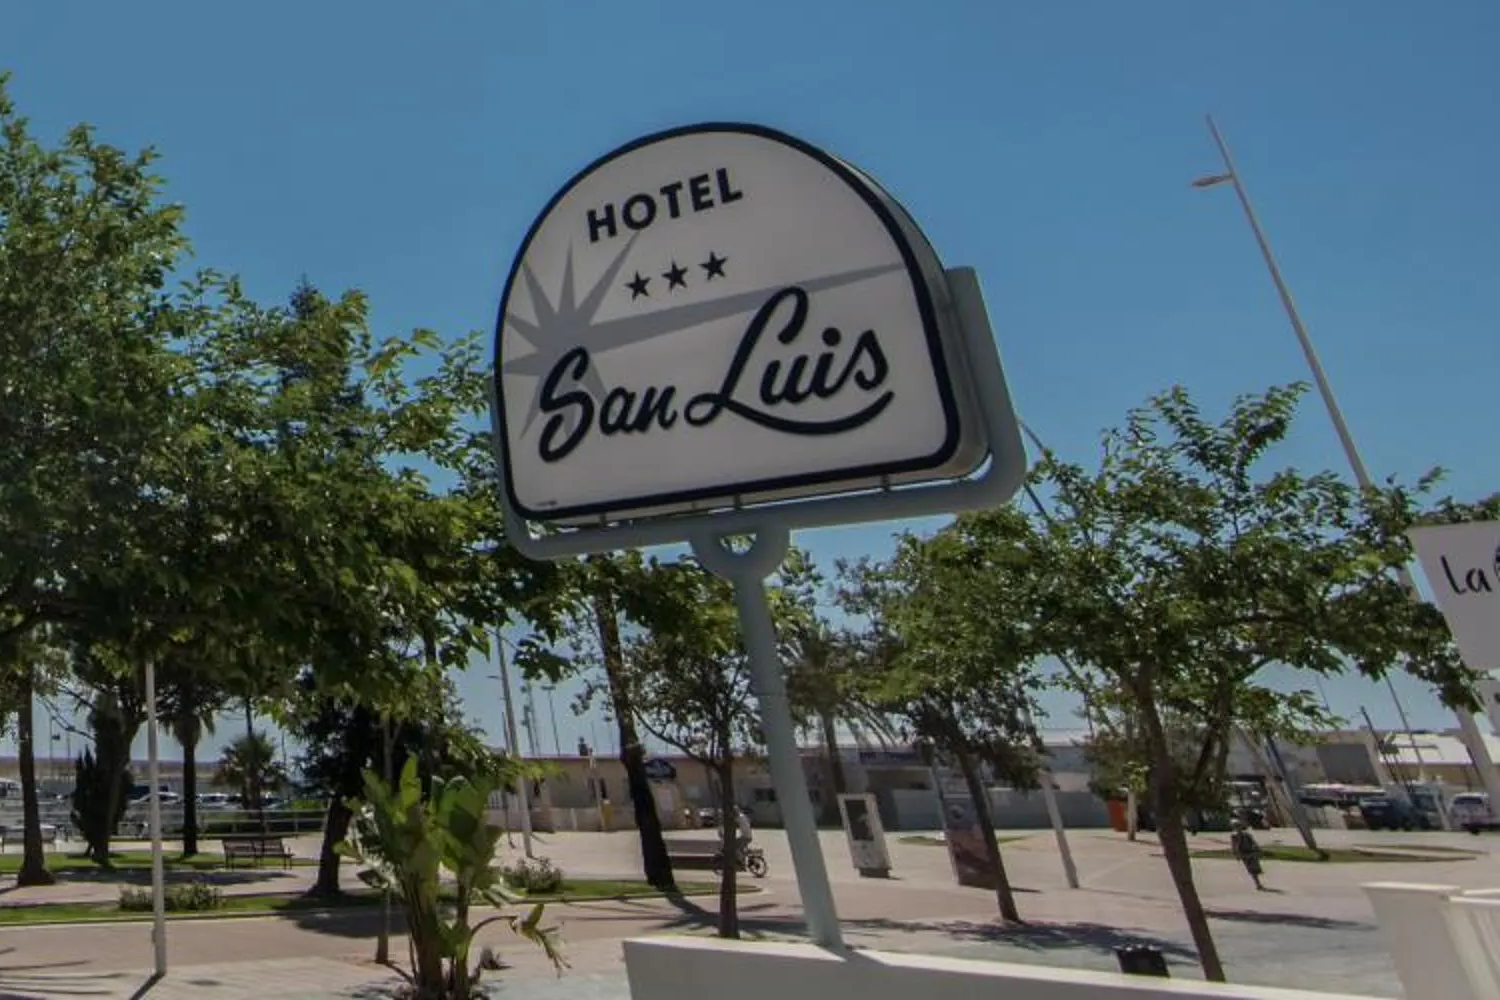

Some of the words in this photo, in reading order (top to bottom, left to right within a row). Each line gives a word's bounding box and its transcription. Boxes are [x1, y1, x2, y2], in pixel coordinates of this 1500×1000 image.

[587, 167, 743, 243] HOTEL
[538, 346, 677, 464] San
[684, 286, 895, 435] Luis
